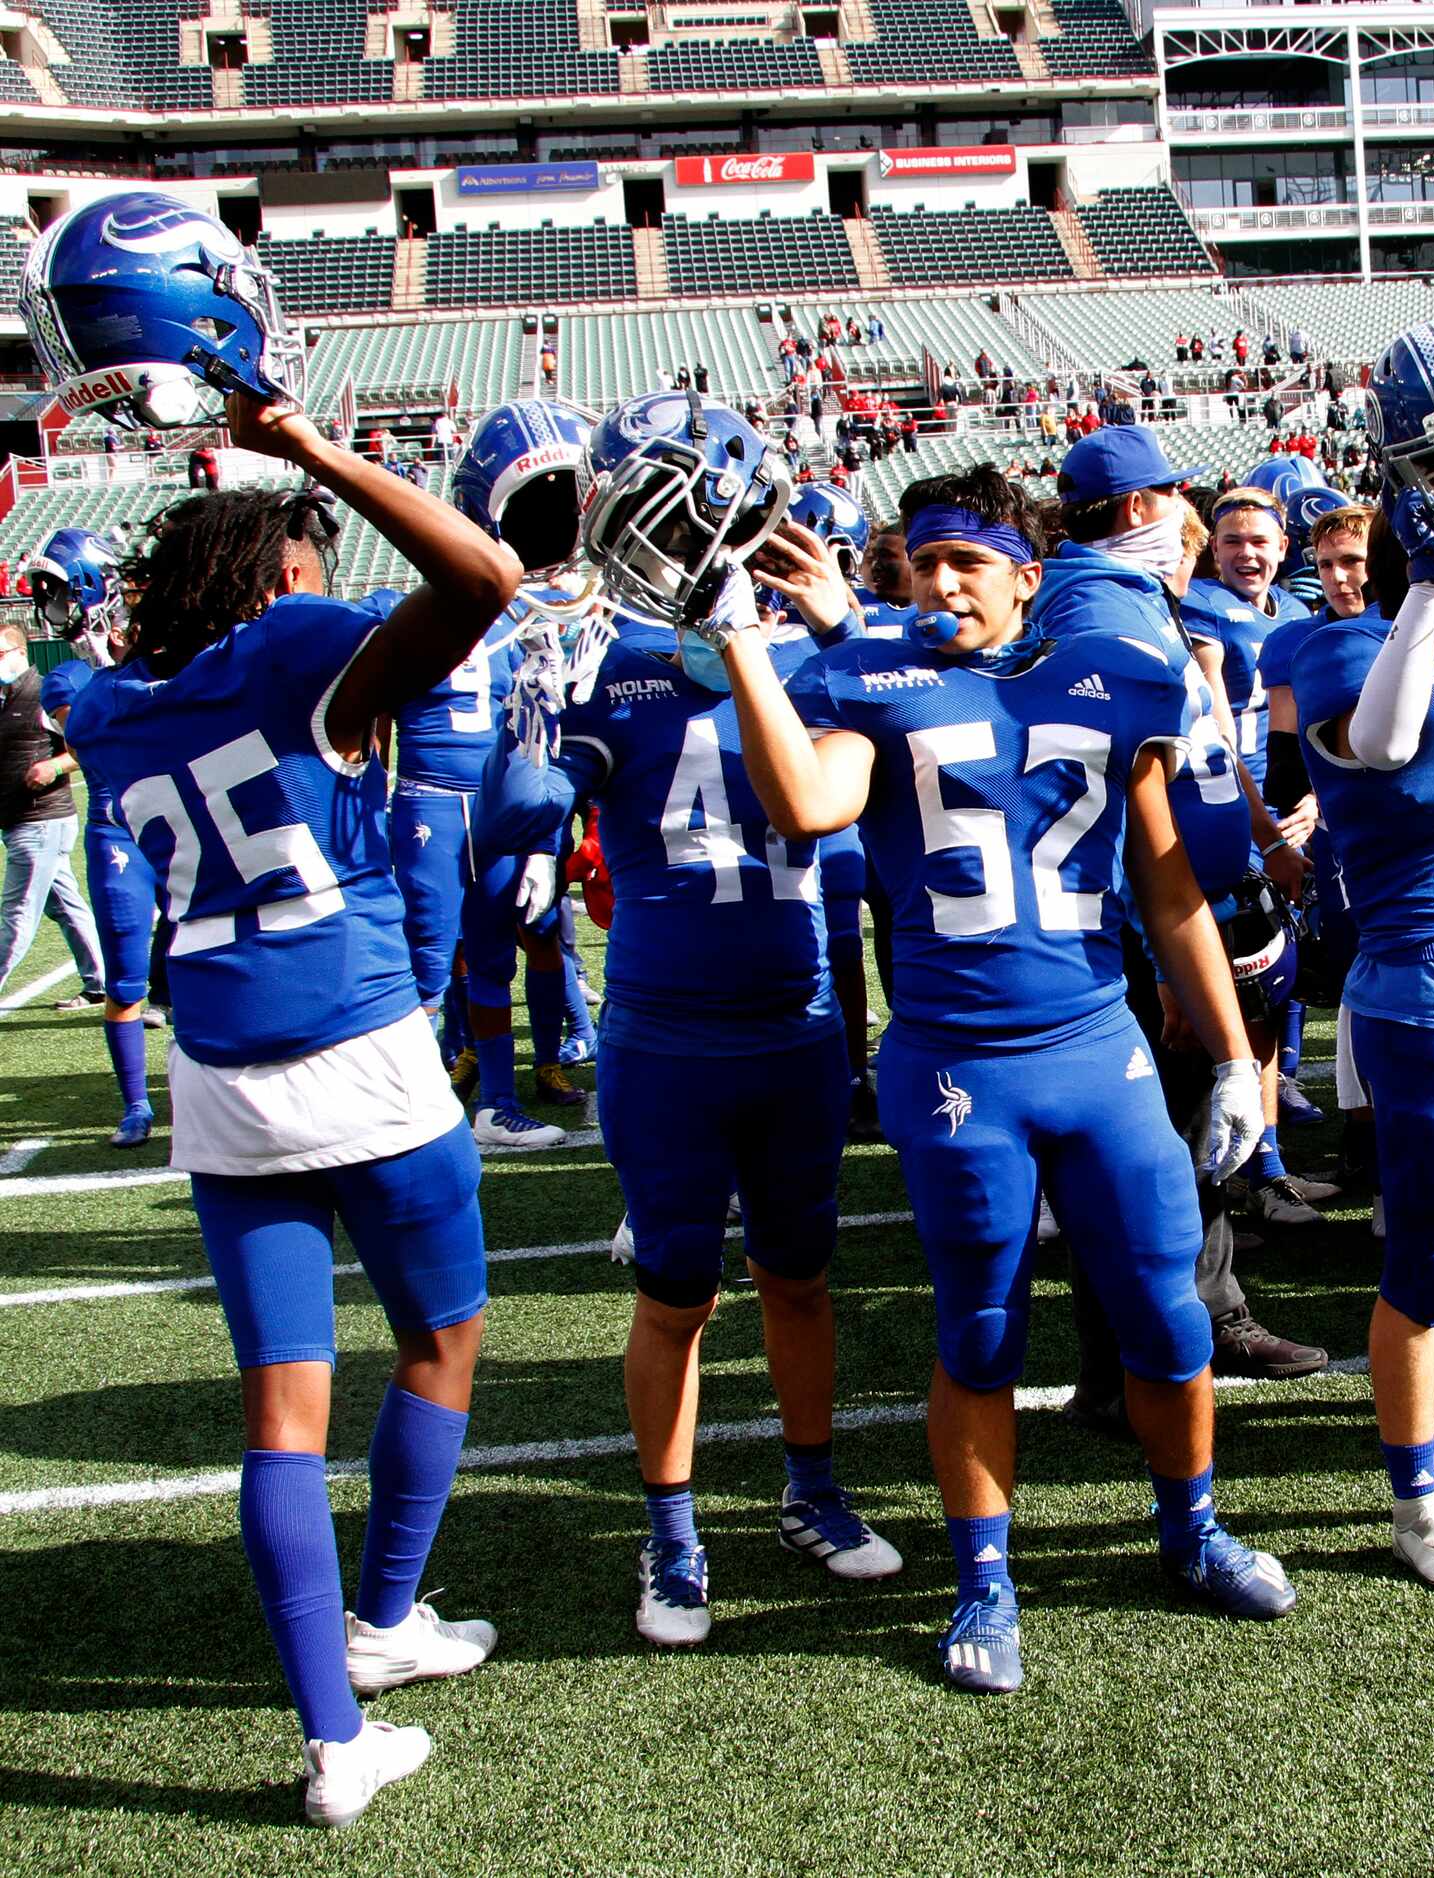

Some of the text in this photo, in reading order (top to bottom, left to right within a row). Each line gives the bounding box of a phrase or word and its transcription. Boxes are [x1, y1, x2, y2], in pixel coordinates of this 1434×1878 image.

[895, 154, 1012, 169] BUSINESS INTERIORS
[605, 679, 674, 699] NOLAN
[1068, 687, 1111, 701] adidas
[905, 721, 1112, 936] 52
[120, 728, 346, 957] 25
